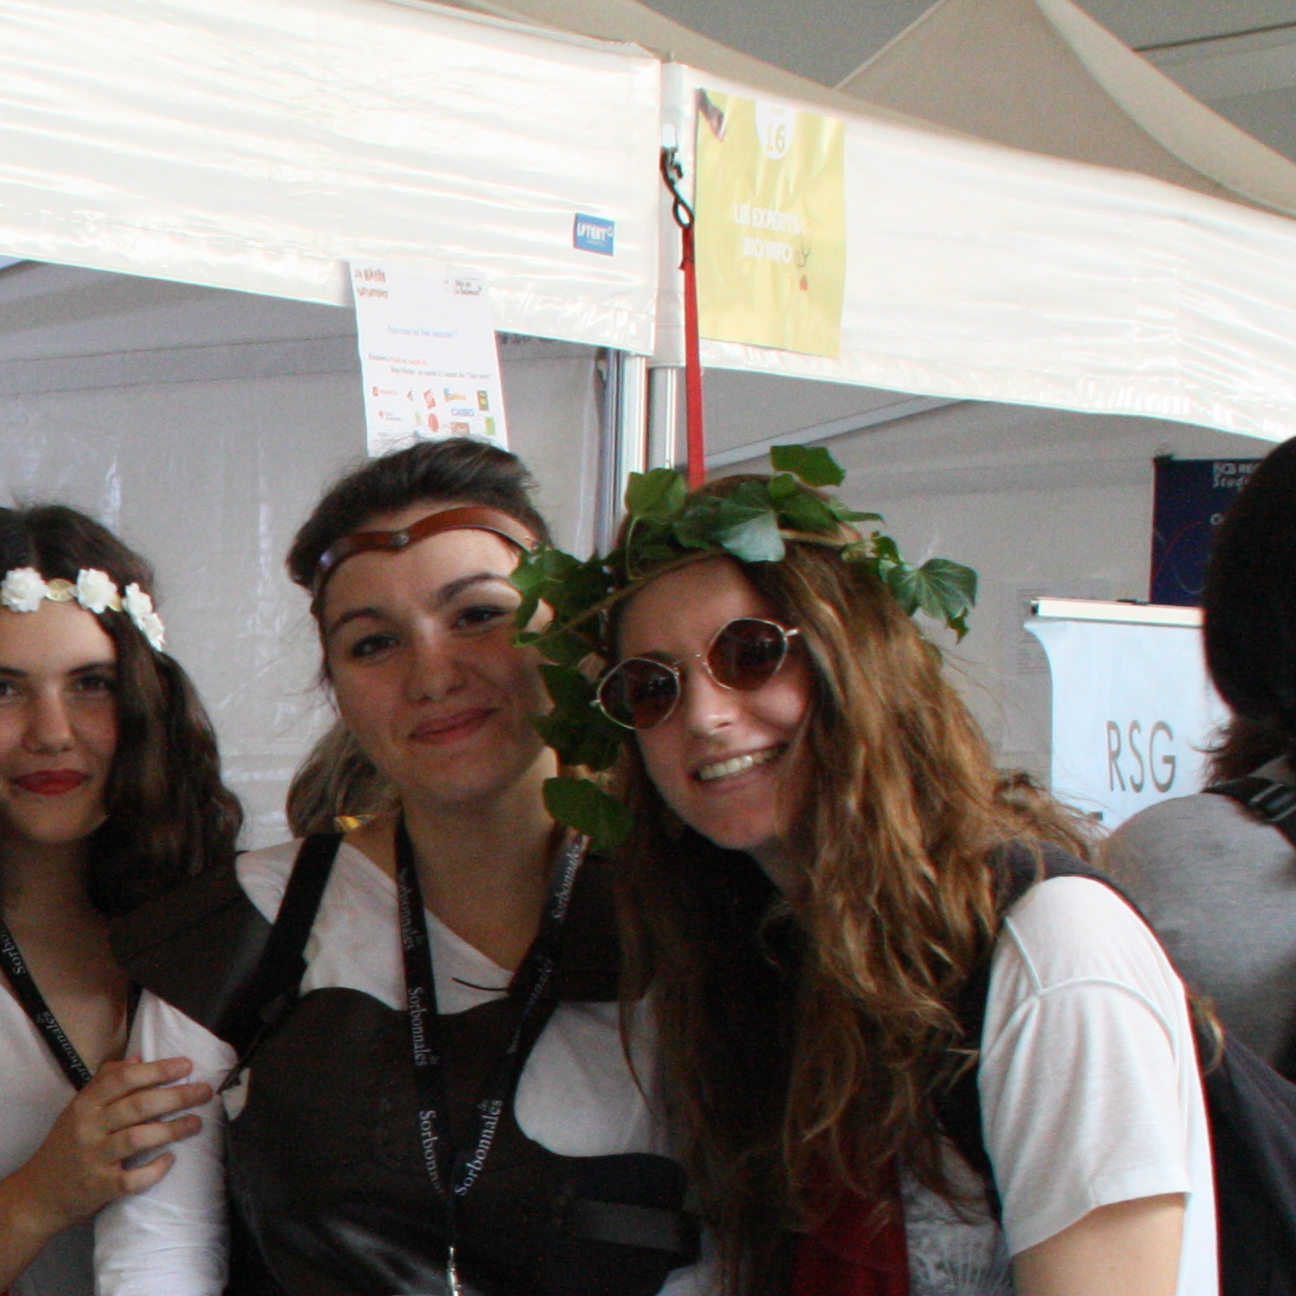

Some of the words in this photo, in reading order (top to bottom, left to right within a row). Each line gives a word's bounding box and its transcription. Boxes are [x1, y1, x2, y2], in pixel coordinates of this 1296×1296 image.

[765, 122, 786, 153] 16
[1106, 720, 1177, 794] RSG
[409, 986, 433, 1067] Sorbonnales
[454, 1100, 503, 1197] Sorbonnales
